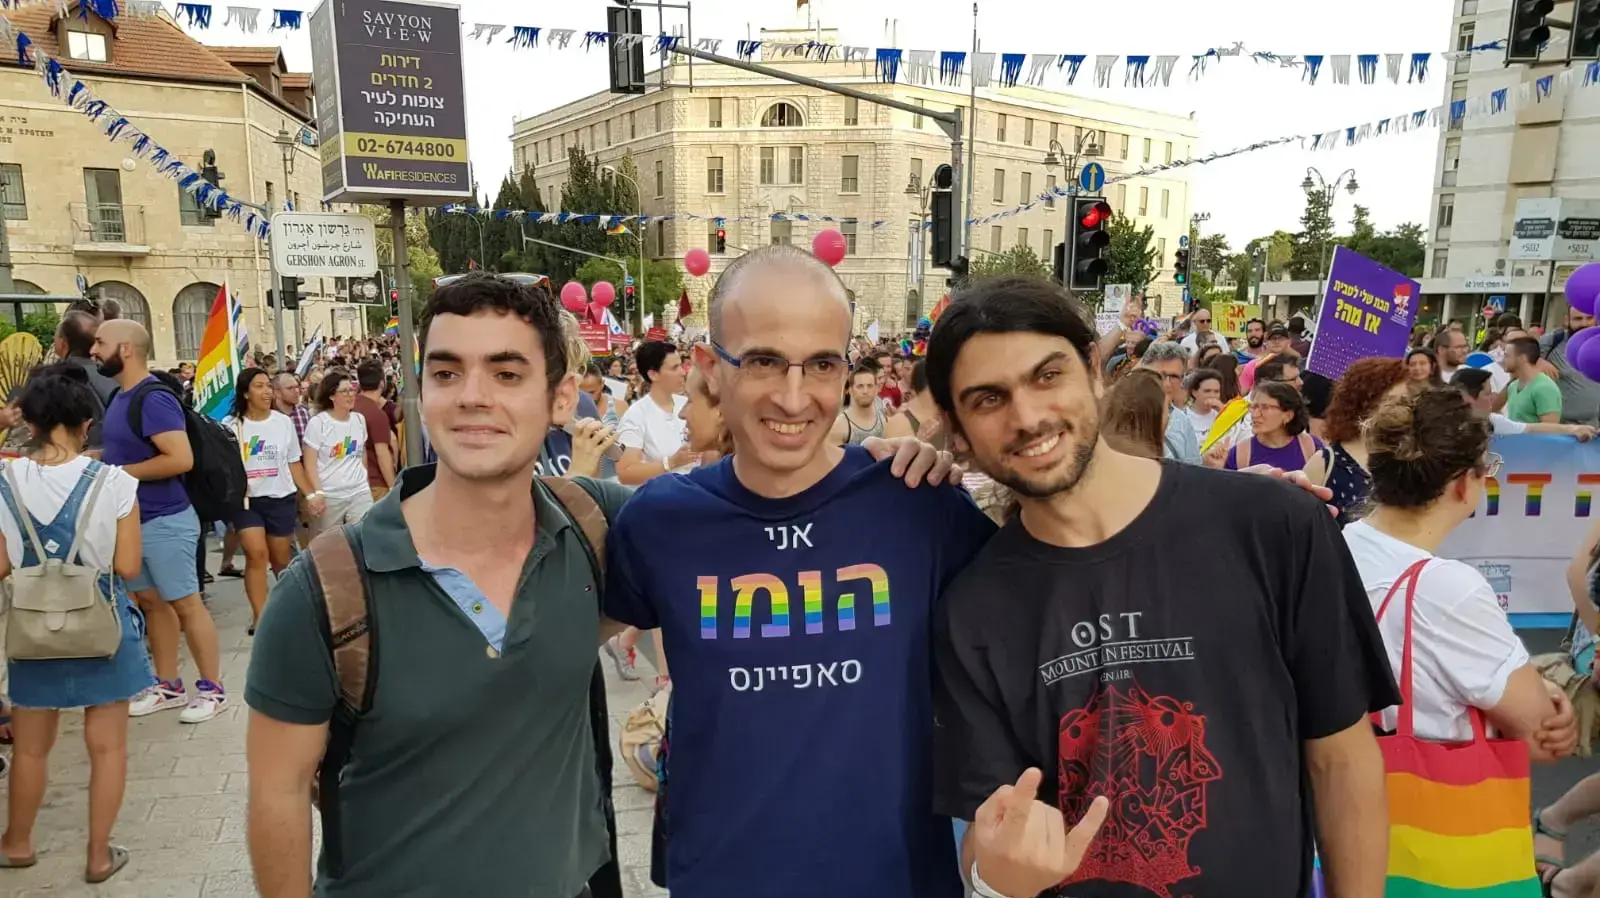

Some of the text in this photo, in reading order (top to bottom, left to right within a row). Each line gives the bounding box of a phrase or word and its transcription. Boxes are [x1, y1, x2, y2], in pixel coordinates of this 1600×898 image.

[363, 10, 432, 30] SAVYON
[380, 54, 420, 69] דירות
[371, 72, 433, 89] 2 חדרים
[361, 90, 444, 109] צופות לעיר
[374, 111, 435, 127] העתיקה
[357, 138, 455, 157] 02-6744800
[286, 255, 325, 267] GERSHON
[328, 255, 357, 267] AGRON
[1360, 288, 1374, 305] שלי
[1373, 297, 1390, 314] הבת
[1334, 298, 1363, 327] מה?
[1364, 312, 1382, 334] אז
[764, 523, 814, 549] אני
[697, 563, 891, 640] הומו
[1071, 611, 1142, 648] OST
[1040, 641, 1194, 683] MOUNTIN FESTIVAL
[728, 659, 863, 691] סאפיינס
